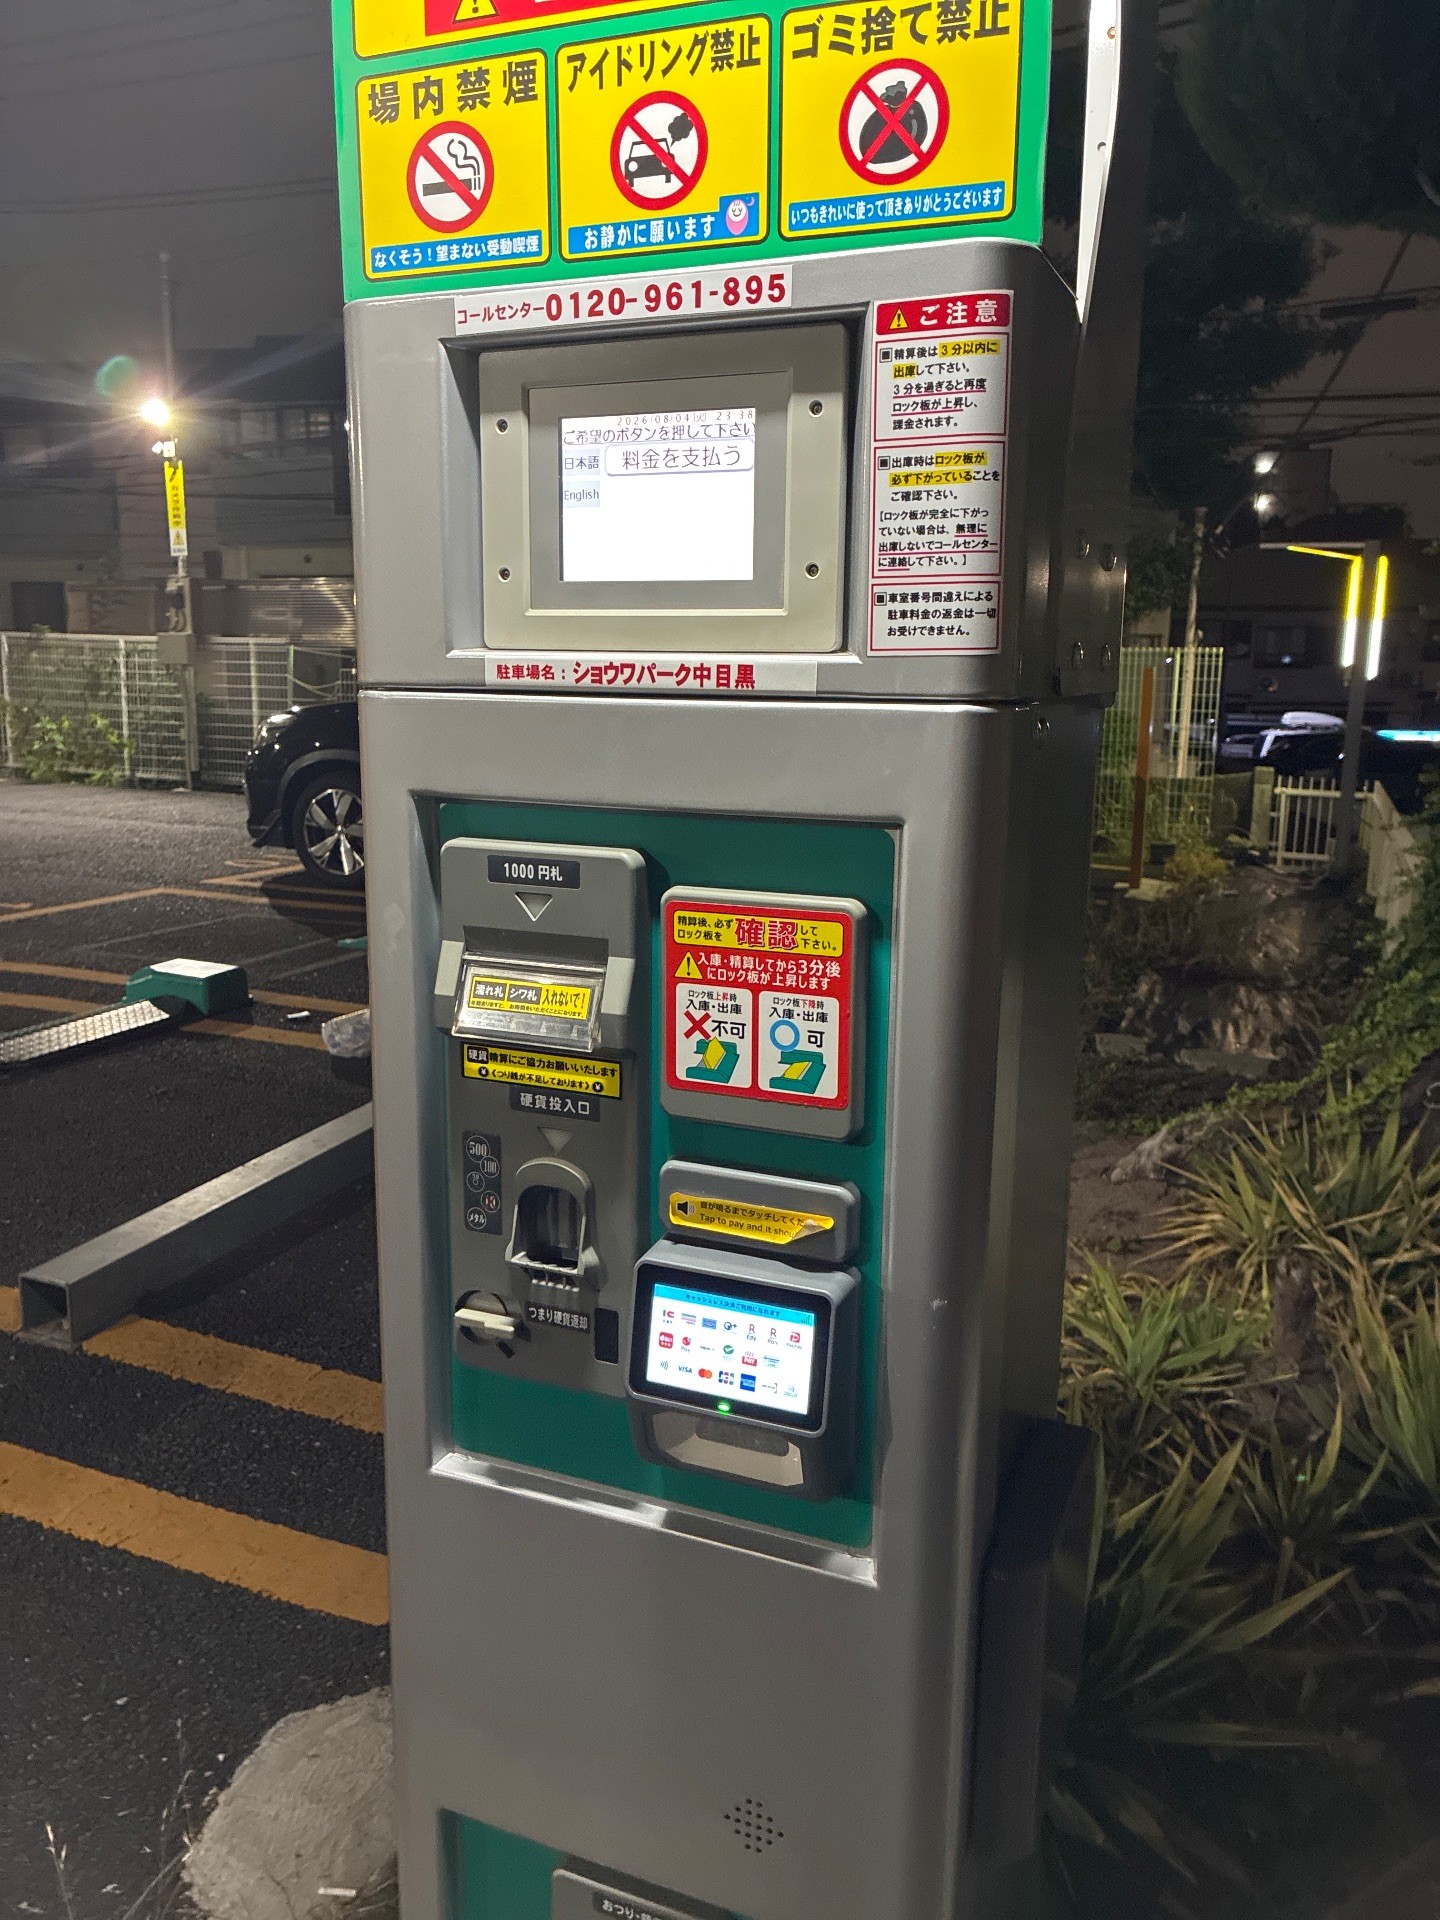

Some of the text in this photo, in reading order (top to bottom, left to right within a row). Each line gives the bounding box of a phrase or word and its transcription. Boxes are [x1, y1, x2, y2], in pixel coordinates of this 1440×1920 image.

[792, 0, 1010, 59] ゴミ捨て禁止
[566, 24, 761, 93] アイドリング禁止
[368, 59, 538, 125] 場内禁煙
[791, 187, 1003, 225] いつもきれいに使って頂きありがとうございます
[584, 214, 716, 250] お静かに願います
[457, 273, 787, 325] コールセンター 0120-961-895
[920, 299, 998, 326] ご注意
[893, 362, 970, 378] 出庫して下さい。
[892, 397, 978, 412] ロック板が上昇し、
[893, 416, 958, 431] 課金されます。
[564, 455, 600, 470] 日本語
[622, 446, 741, 470] 料金を支払う
[892, 452, 985, 468] 出庫時はロック板が
[891, 470, 1000, 486] 必ず下がっていることを
[564, 489, 600, 502] English
[891, 489, 958, 502] ご確認下さい。
[879, 538, 998, 553] 出庫しないでコールセンター
[888, 591, 993, 604] 車室番号間違えによる
[888, 608, 996, 620] 駐車料金の返金は一切
[887, 625, 971, 637] お受けできません。
[677, 915, 734, 930] 精算後、必ず
[800, 924, 818, 936] して
[677, 929, 722, 942] ロック板を
[735, 917, 798, 950] 確認
[800, 938, 837, 951] 下さい。
[707, 968, 831, 991] にロック板が上昇します
[509, 988, 538, 1001] シワ札
[688, 989, 737, 1003] ロック板上昇時
[685, 999, 742, 1015] 入庫・出庫
[772, 996, 825, 1010] ロック板下降時
[769, 1006, 829, 1023] 入庫・出庫
[711, 1019, 747, 1039] 不可
[807, 1029, 825, 1048] 可
[520, 1092, 590, 1115] 硬貨投入口
[469, 1141, 487, 1156] 500
[483, 1160, 497, 1174] 100
[700, 1213, 715, 1224] Tap
[718, 1216, 727, 1226] to
[729, 1219, 744, 1230] pay
[746, 1221, 763, 1233] and
[765, 1225, 772, 1234] it
[528, 1307, 588, 1330] つまり硬貨返却
[678, 1365, 693, 1374] VISA
